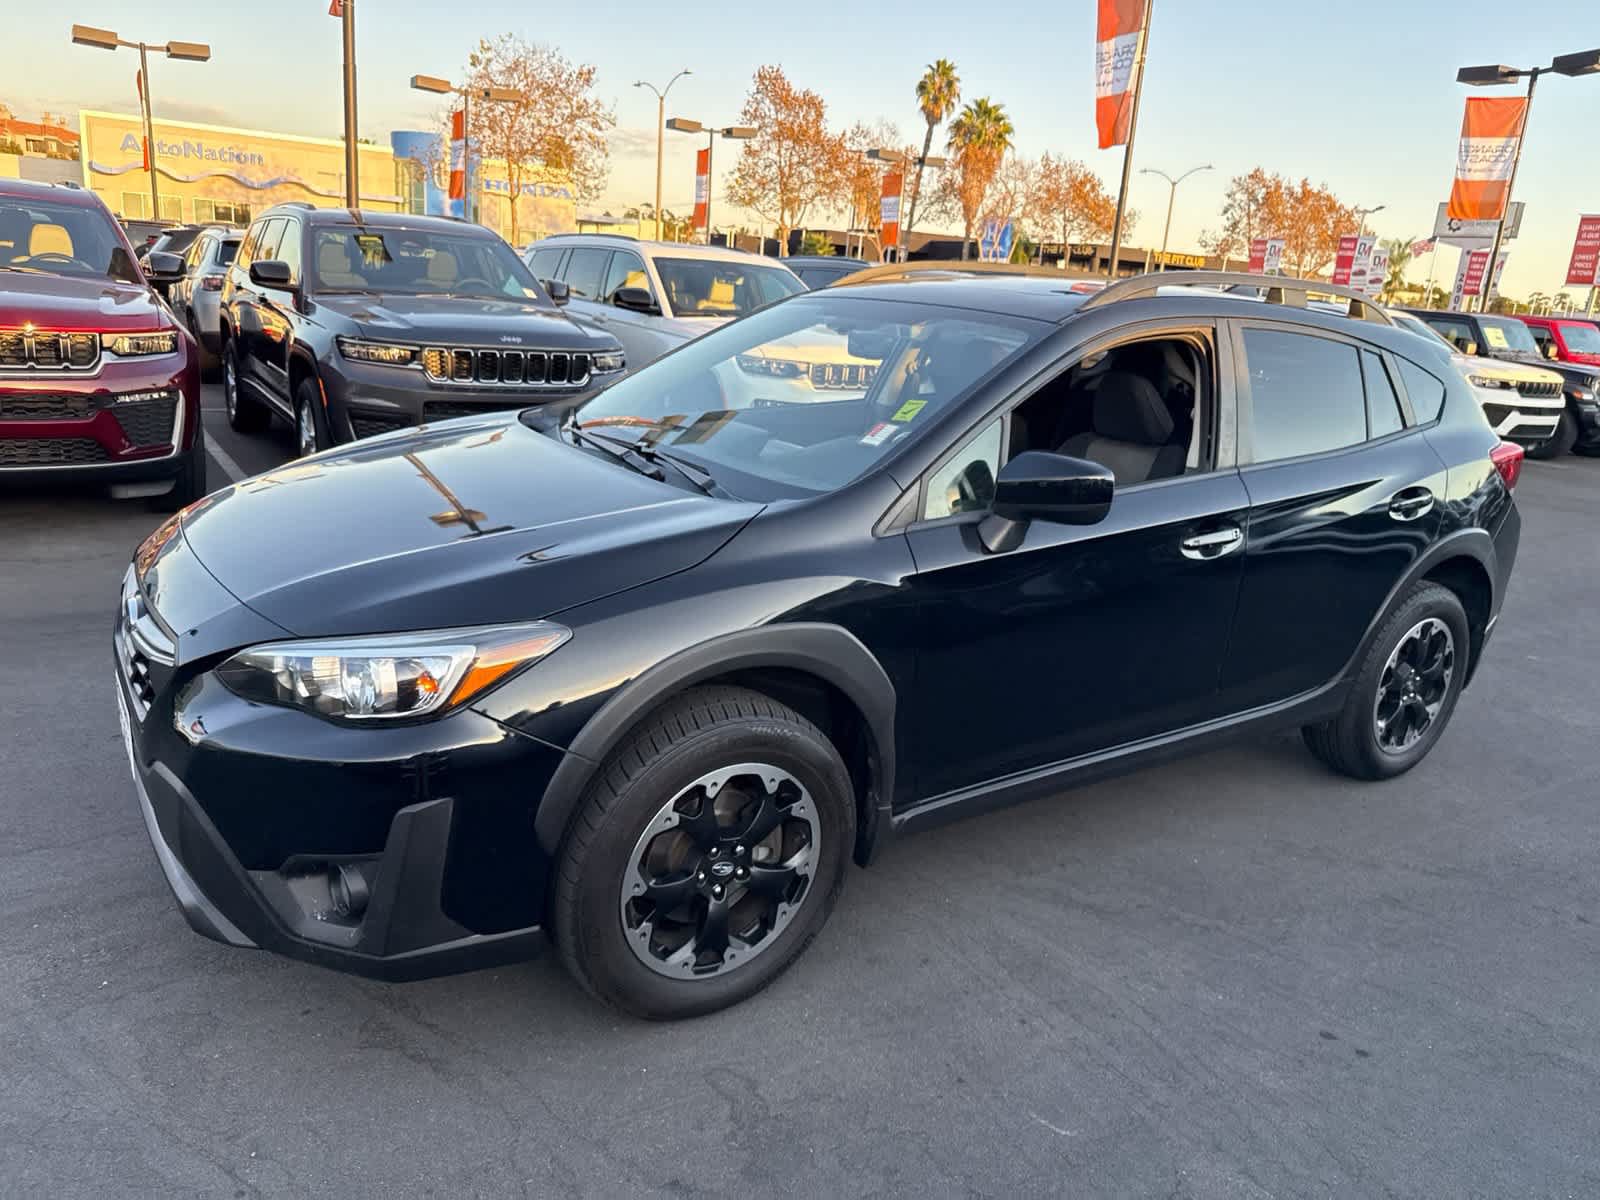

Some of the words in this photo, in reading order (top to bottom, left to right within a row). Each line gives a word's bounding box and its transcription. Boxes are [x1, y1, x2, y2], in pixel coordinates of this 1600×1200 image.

[119, 133, 264, 166] AtoNation
[1171, 254, 1185, 265] FIT
[1185, 255, 1206, 268] CLUB
[500, 335, 522, 344] Jeep
